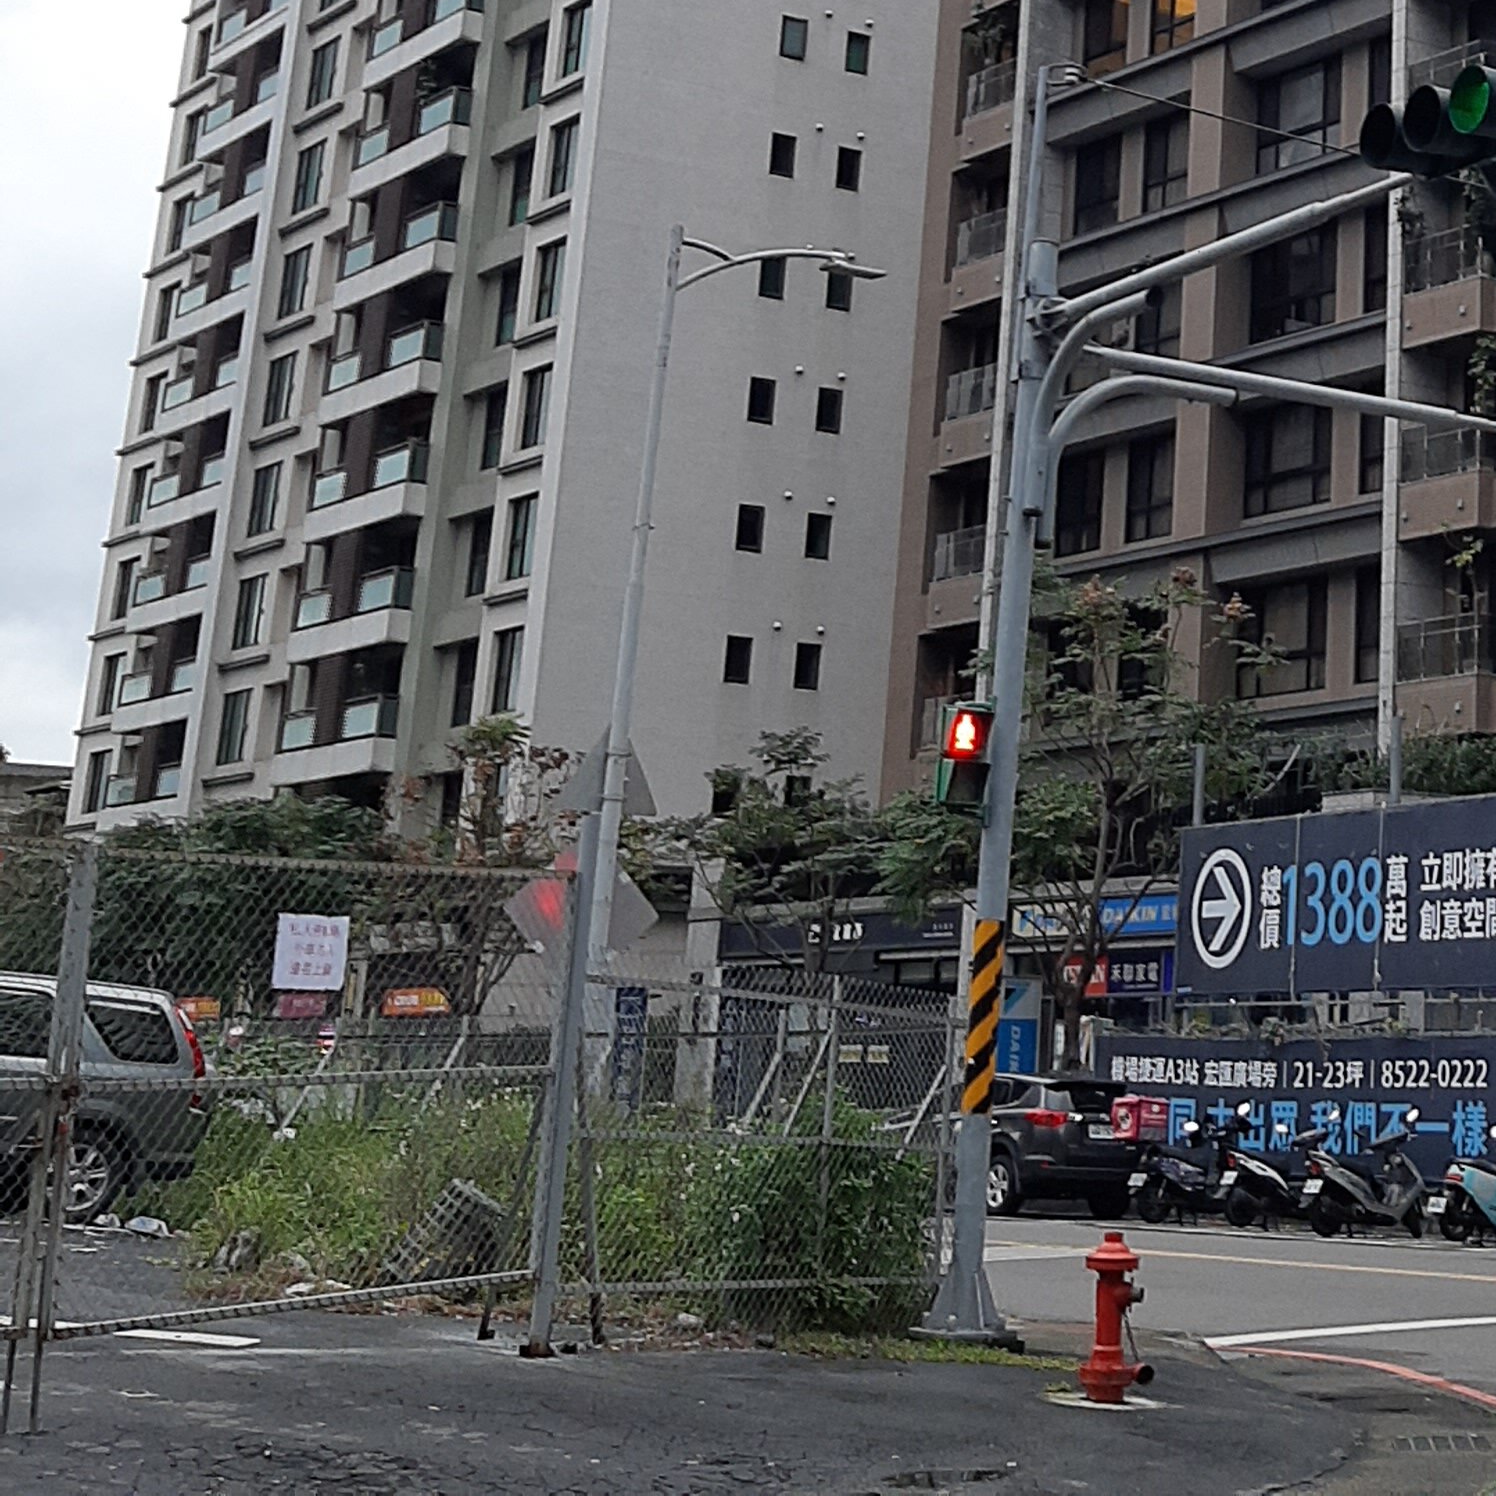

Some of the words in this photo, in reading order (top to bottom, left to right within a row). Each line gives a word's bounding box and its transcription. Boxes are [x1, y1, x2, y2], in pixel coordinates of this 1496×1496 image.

[1260, 865, 1281, 950] 總價
[1283, 857, 1382, 945] 1388
[1384, 855, 1408, 943] 萬起
[1293, 1060, 1364, 1089] 21-23坪
[1381, 1059, 1488, 1089] 8522-0222
